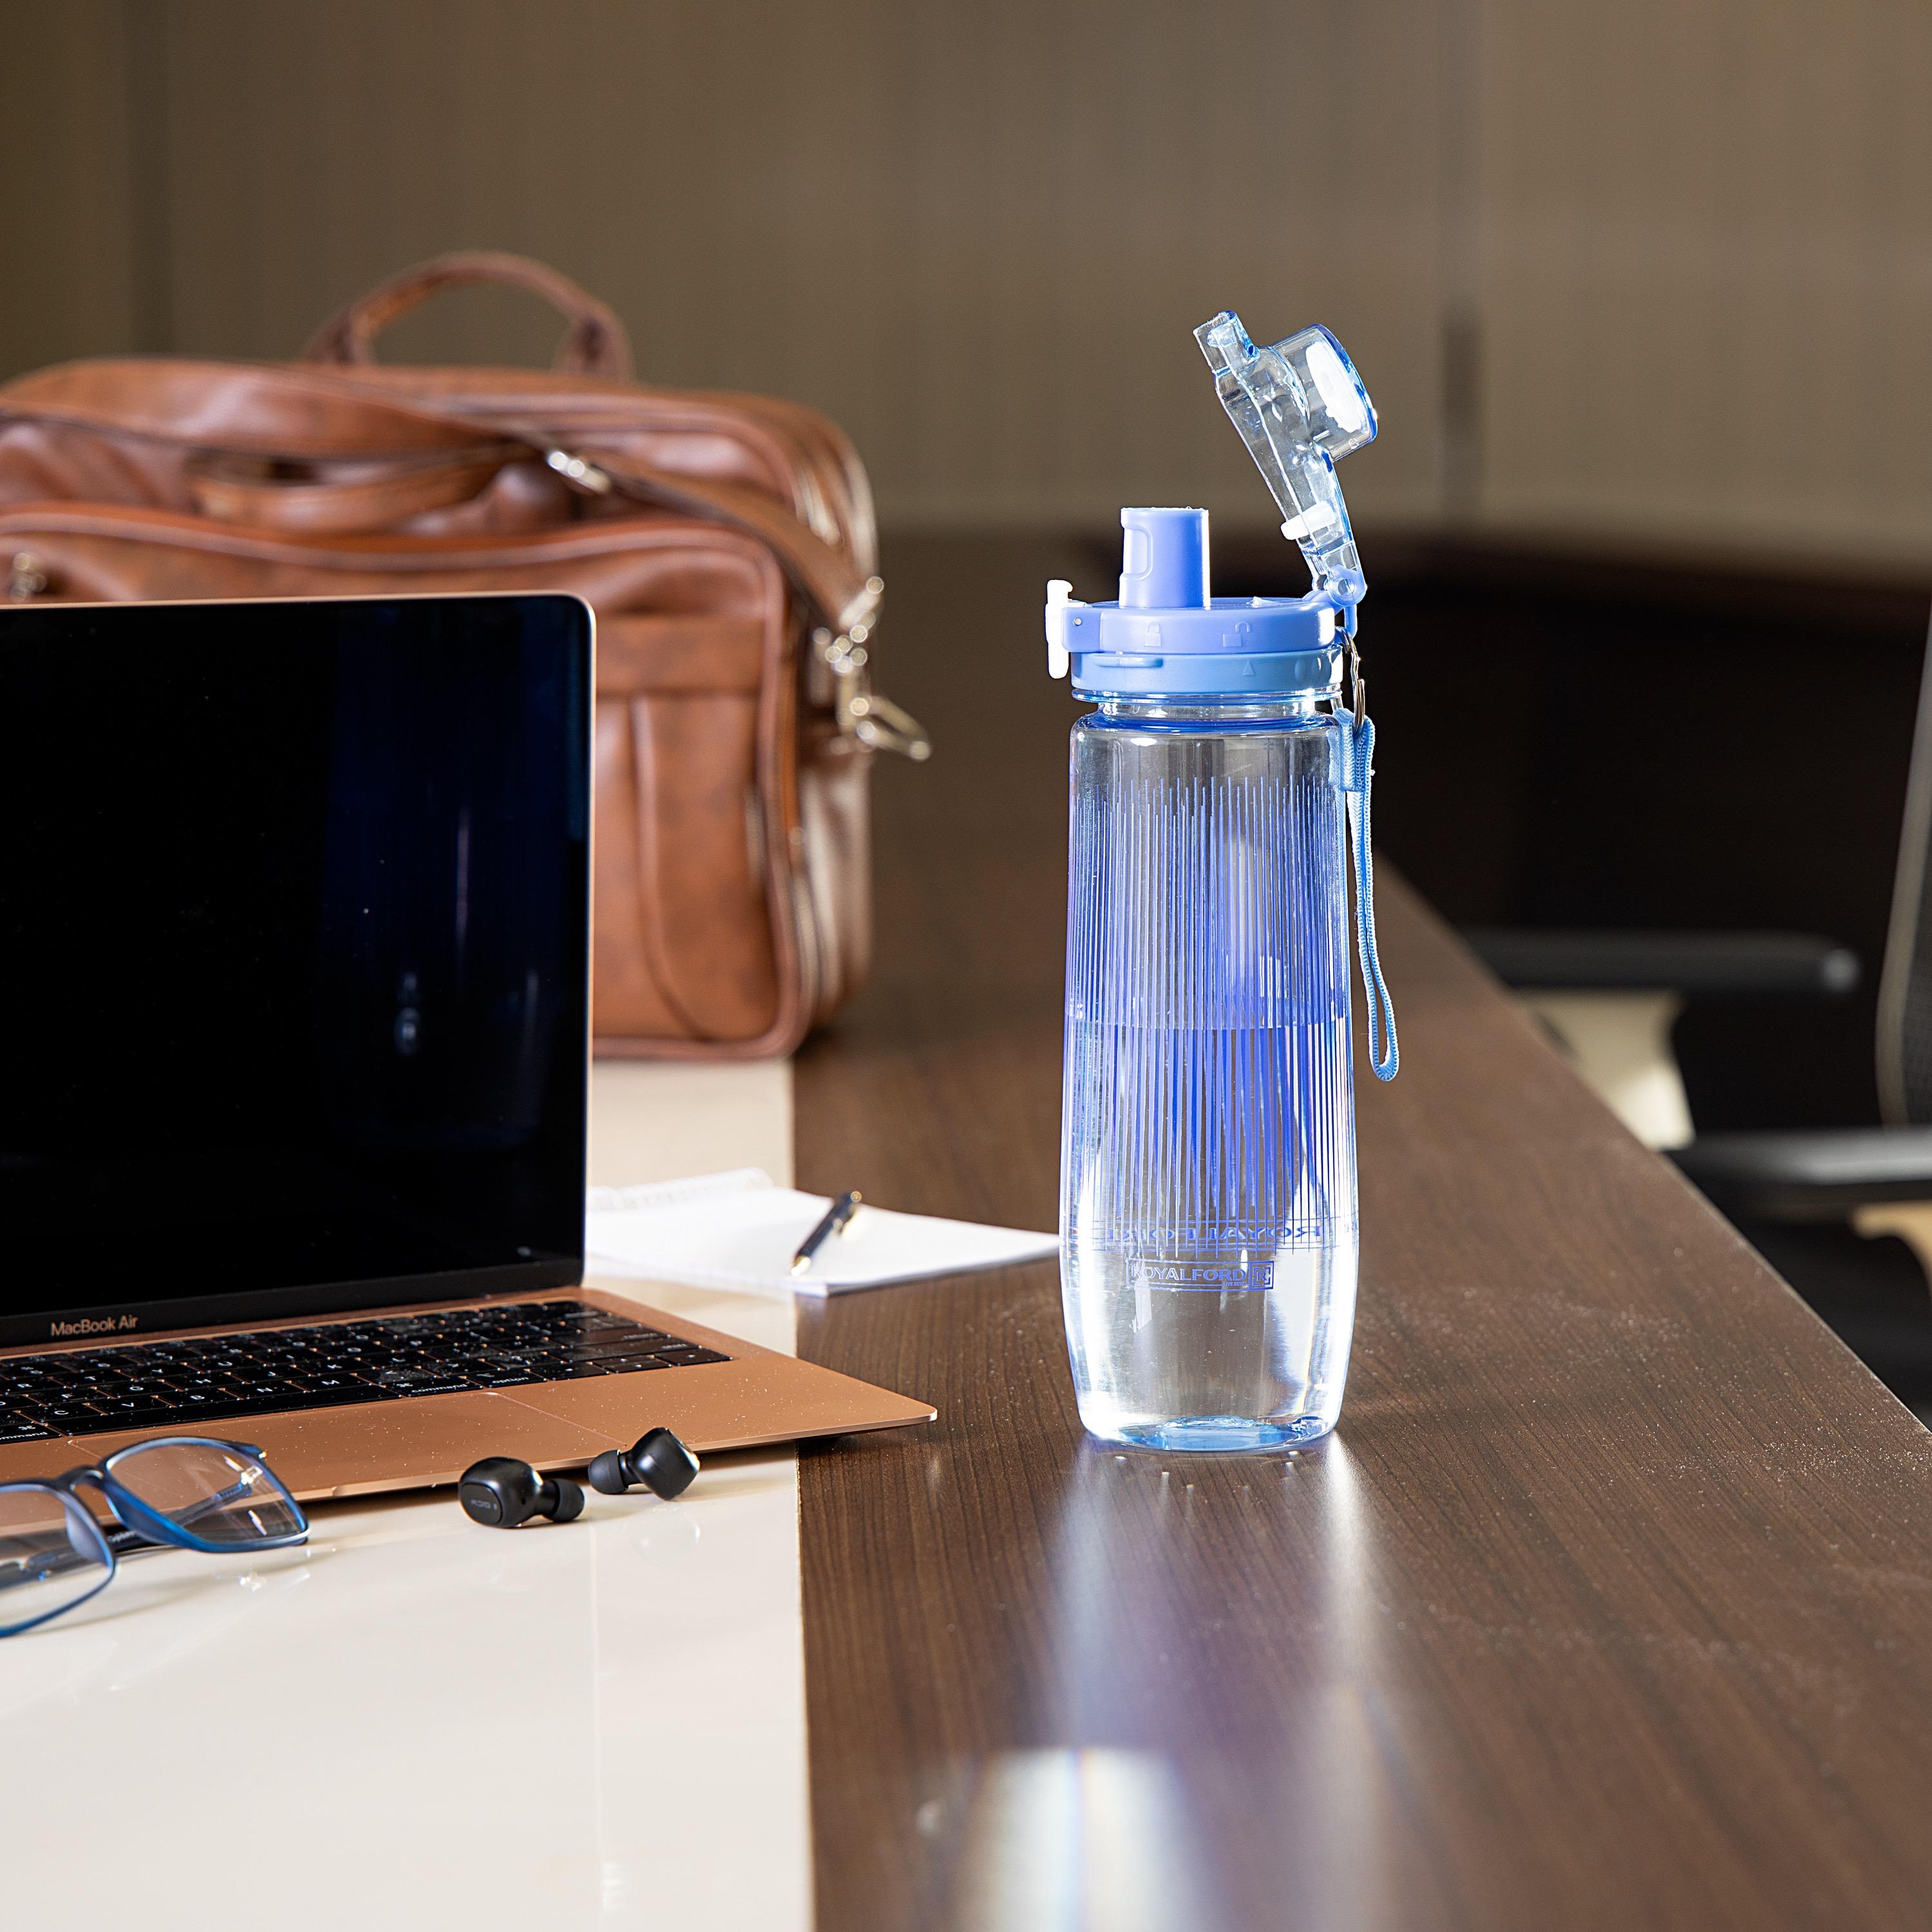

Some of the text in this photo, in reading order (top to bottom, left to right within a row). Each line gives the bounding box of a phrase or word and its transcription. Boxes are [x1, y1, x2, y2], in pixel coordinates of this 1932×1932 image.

[1131, 1263, 1247, 1281] ROYALFORD
[51, 1314, 138, 1337] MacBook Air
